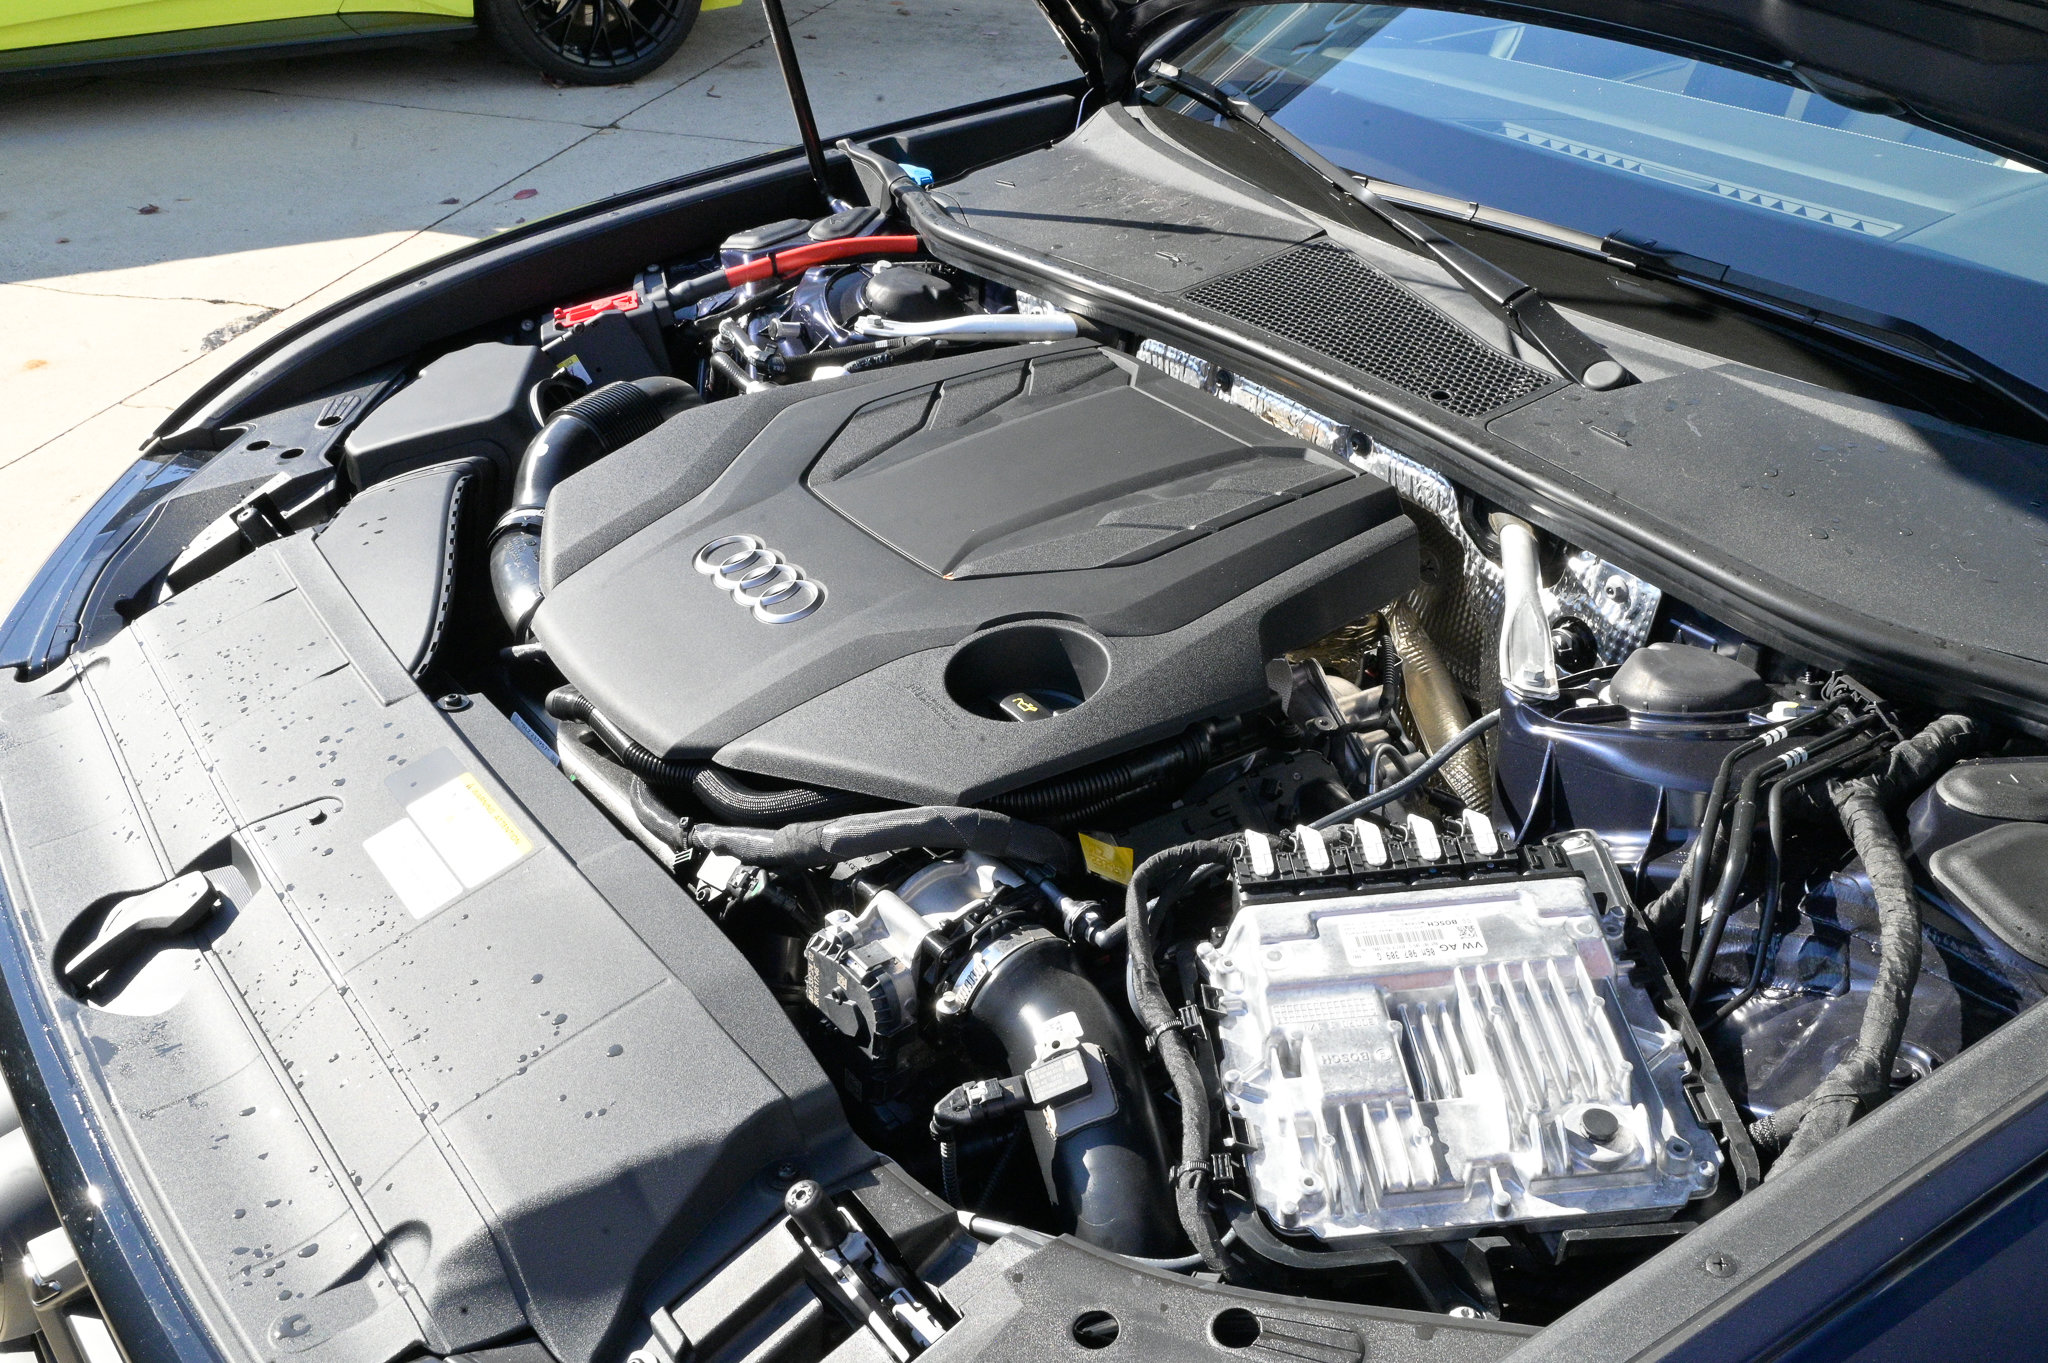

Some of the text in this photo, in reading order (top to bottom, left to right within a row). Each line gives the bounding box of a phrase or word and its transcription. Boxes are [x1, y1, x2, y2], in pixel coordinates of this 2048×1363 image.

[1427, 919, 1458, 927] BOSCH
[1439, 944, 1457, 952] AG
[1462, 941, 1484, 950] VW
[1321, 1051, 1370, 1065] BOSCH
